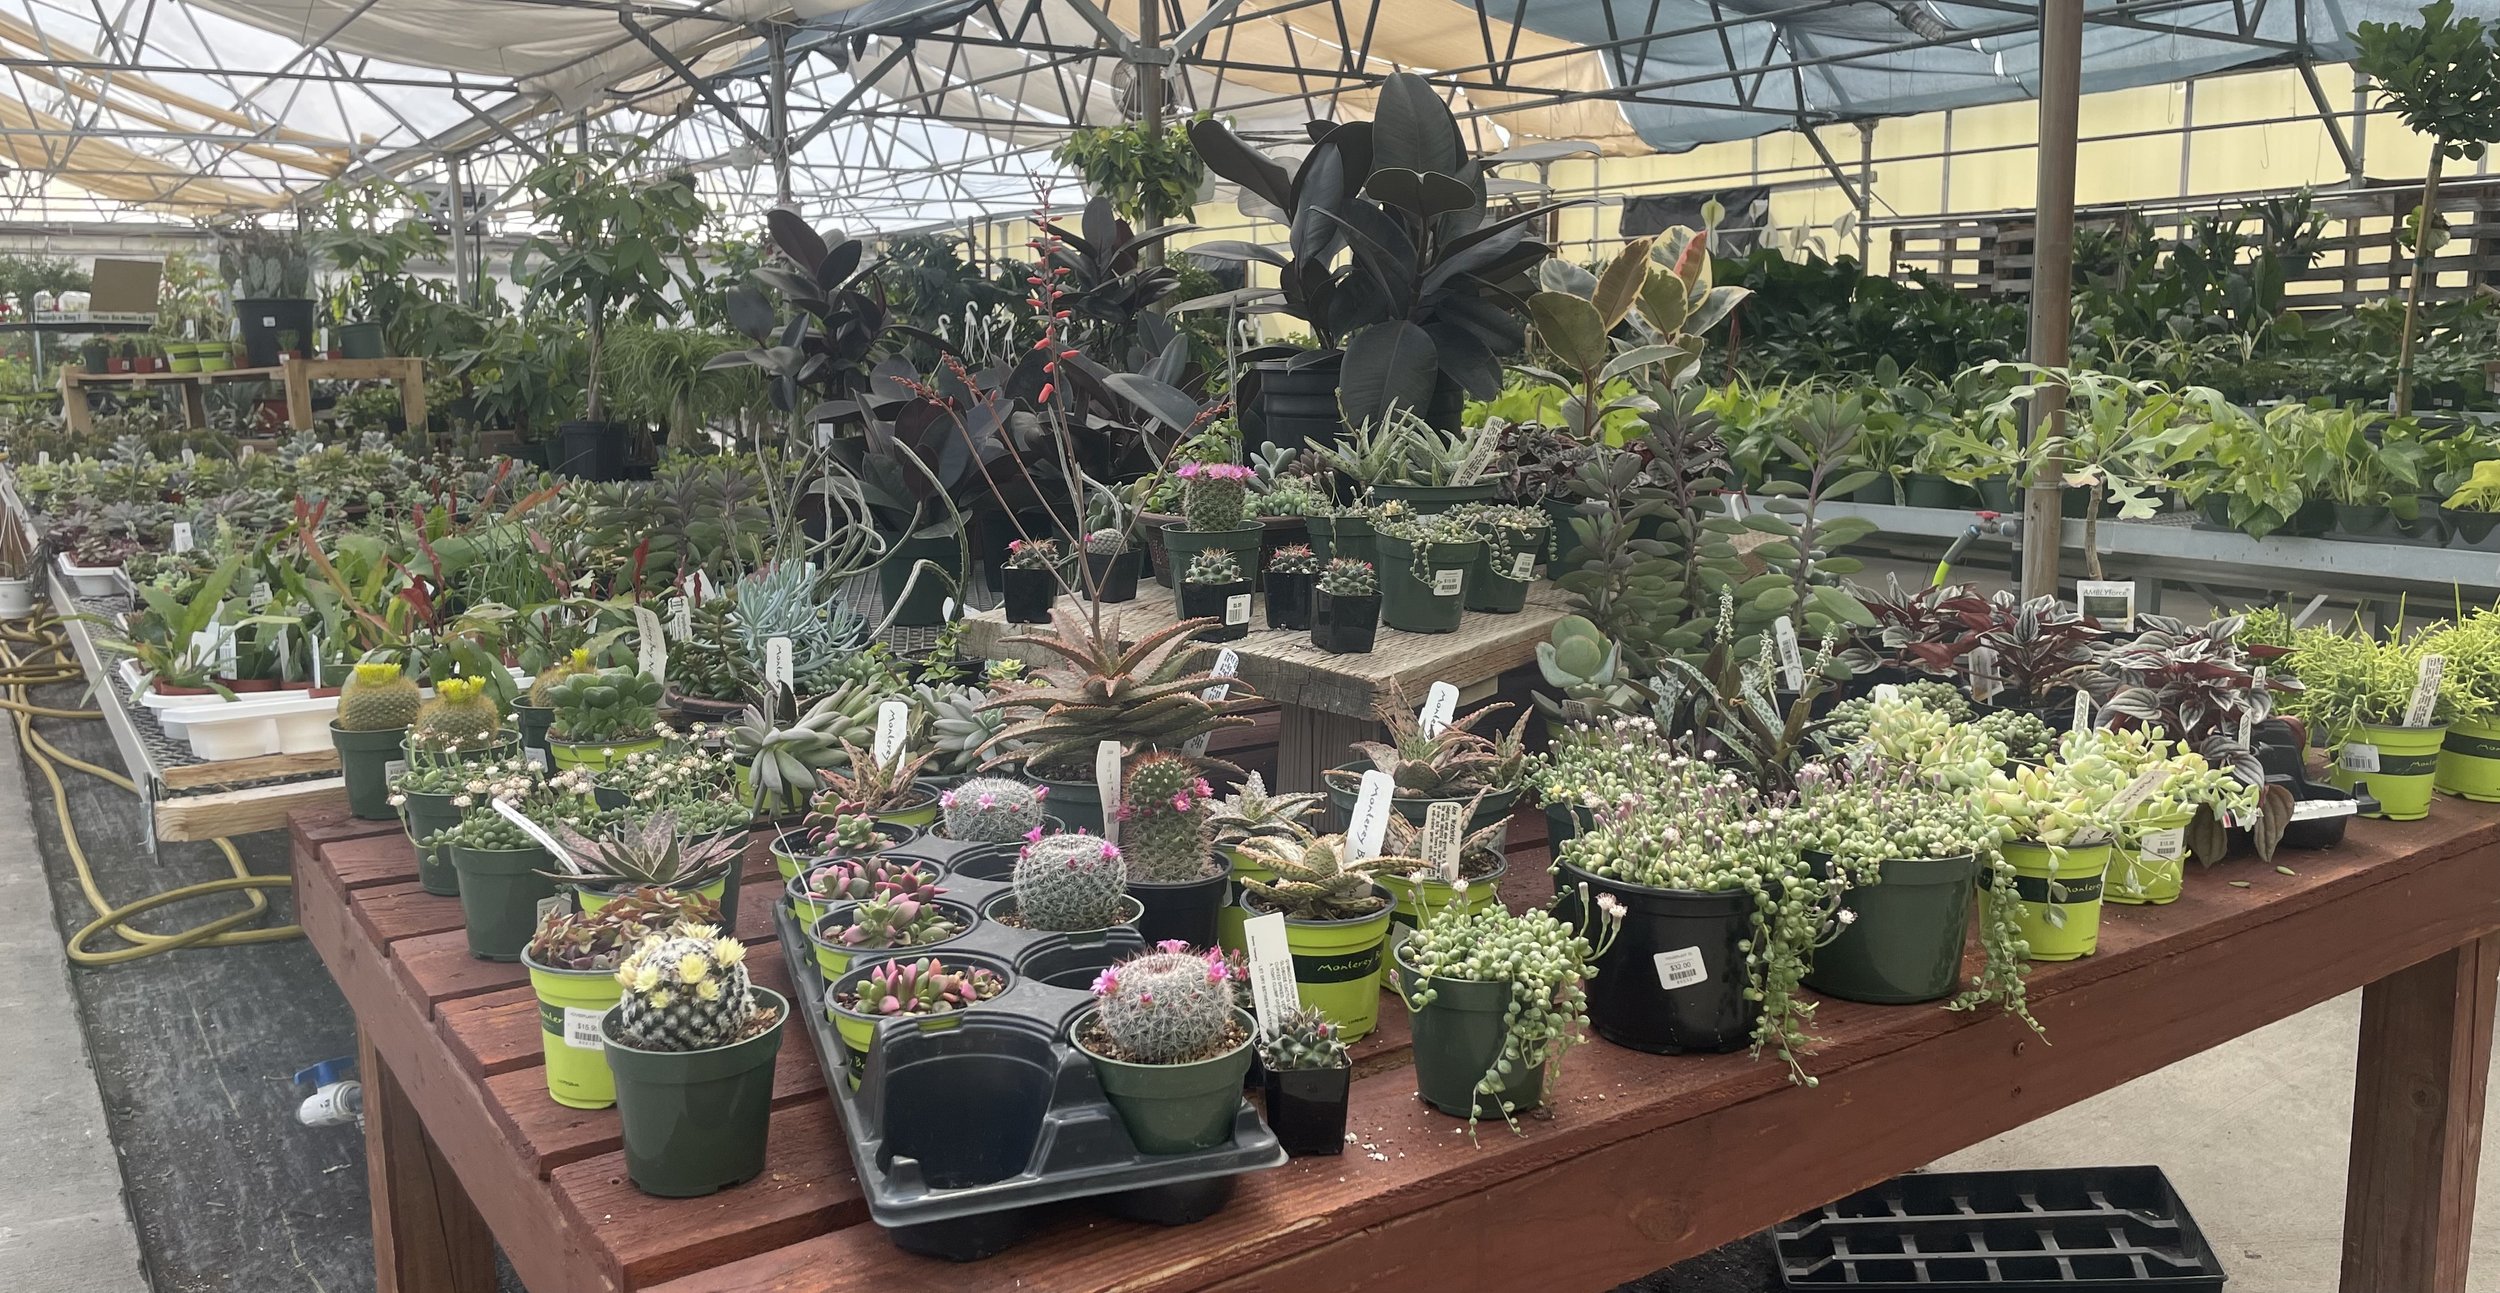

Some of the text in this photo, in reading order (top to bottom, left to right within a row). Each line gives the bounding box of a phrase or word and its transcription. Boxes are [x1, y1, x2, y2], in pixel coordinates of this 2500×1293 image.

[881, 708, 896, 761] Monterey
[1357, 782, 1380, 846] Monterey
[1317, 957, 1373, 972] Monterey
[1670, 962, 1691, 971] $32.00
